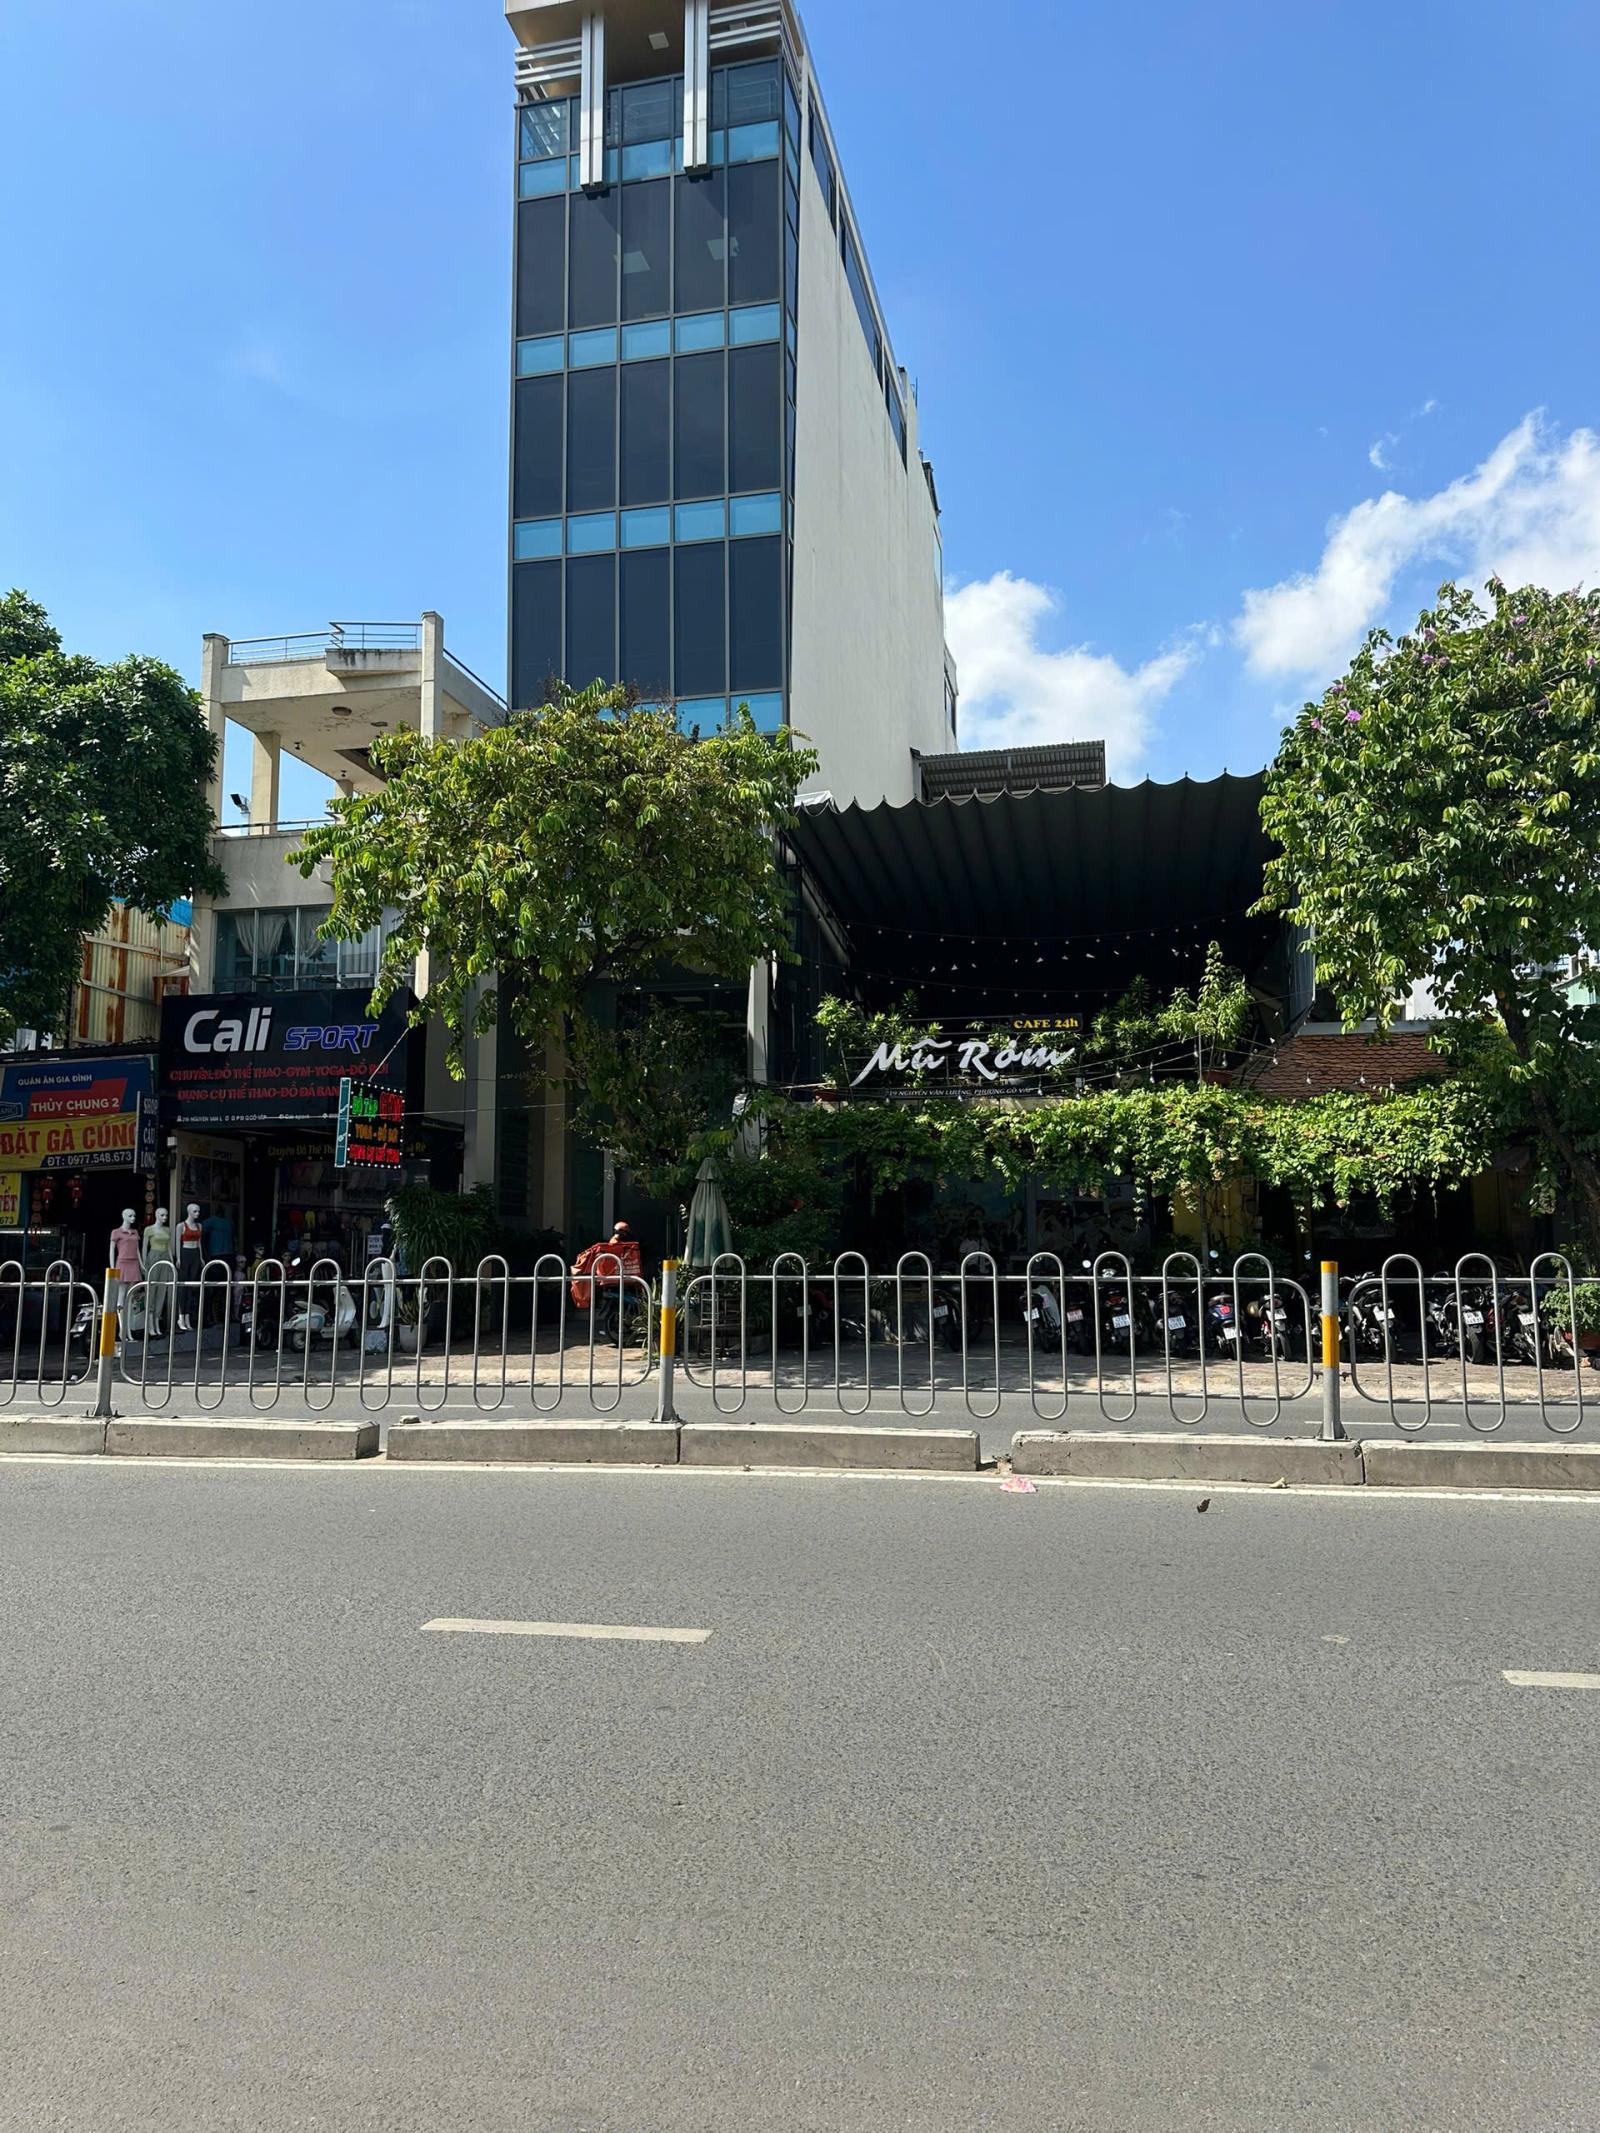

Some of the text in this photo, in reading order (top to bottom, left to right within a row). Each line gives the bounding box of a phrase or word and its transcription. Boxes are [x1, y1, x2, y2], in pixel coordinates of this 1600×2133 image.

[184, 1007, 379, 1054] Cali SPORT
[1013, 1017, 1079, 1029] CAFE 24h
[849, 1039, 1075, 1087] Mũ Rơm
[18, 1073, 92, 1086] QUÁN ĂN GIA ĐÌNH
[32, 1098, 120, 1112] THỦY CHUNG 2
[0, 1127, 40, 1158] ĐẶT
[47, 1124, 75, 1153] GÀ
[48, 1151, 132, 1166] ĐT: 0977.548.673
